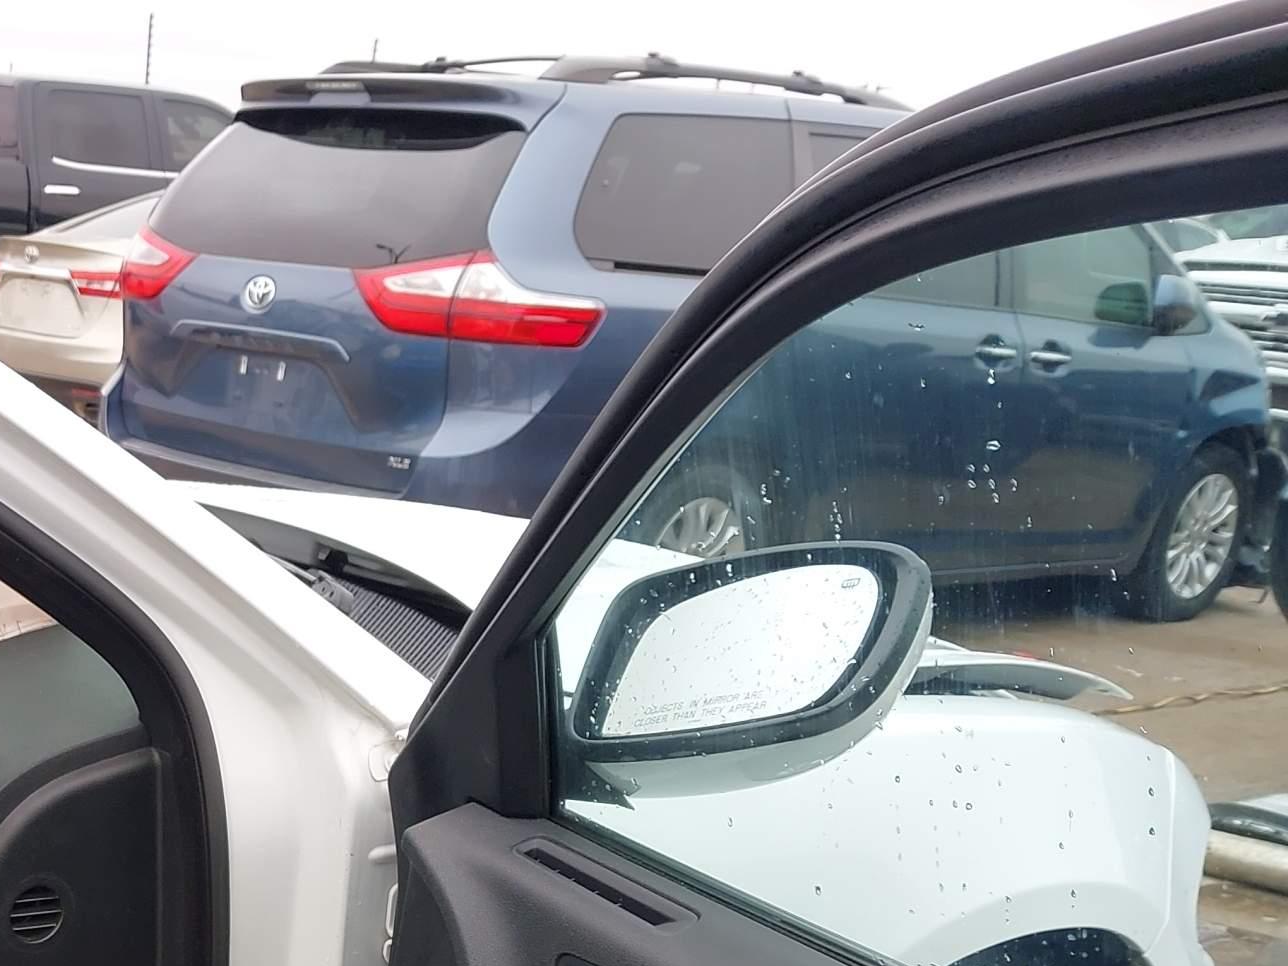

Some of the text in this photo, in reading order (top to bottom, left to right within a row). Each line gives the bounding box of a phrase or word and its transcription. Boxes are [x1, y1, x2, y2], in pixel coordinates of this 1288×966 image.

[703, 694, 740, 706] MIRROR
[634, 701, 767, 728] CLOSER THAN THEY APPEAR
